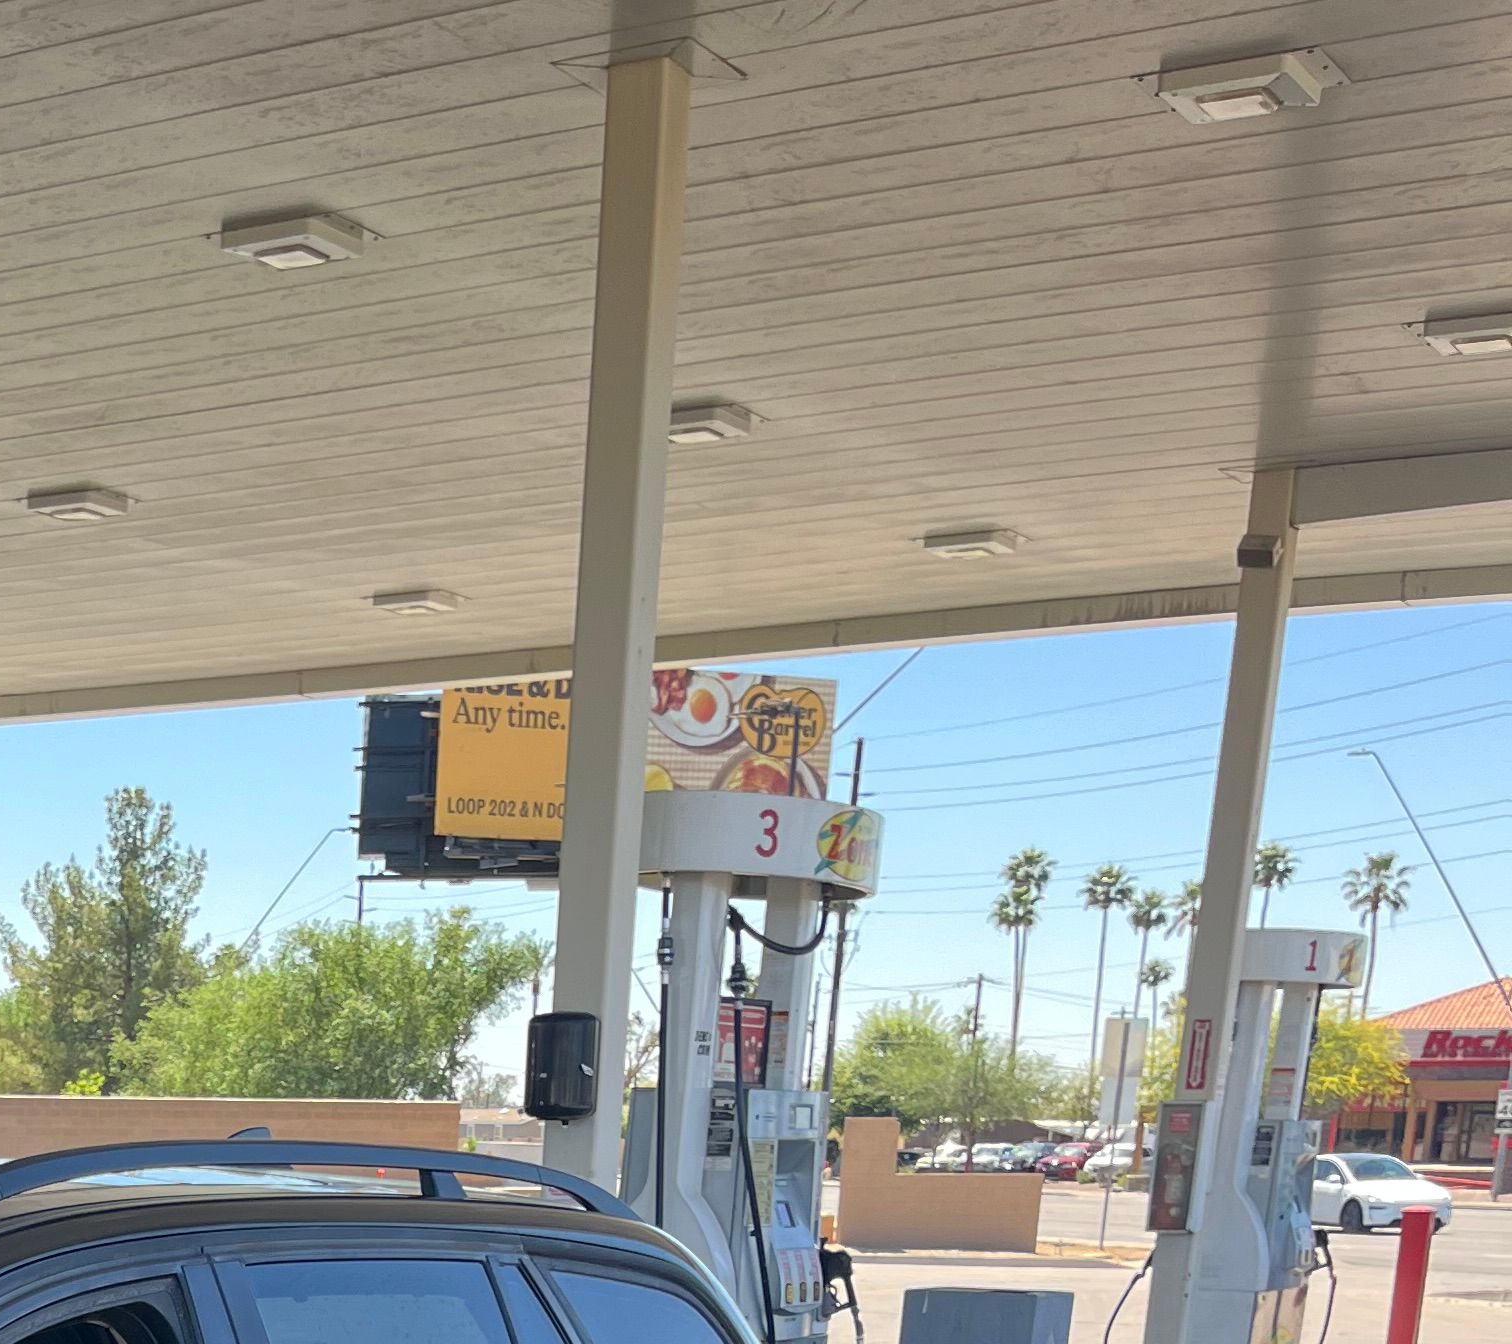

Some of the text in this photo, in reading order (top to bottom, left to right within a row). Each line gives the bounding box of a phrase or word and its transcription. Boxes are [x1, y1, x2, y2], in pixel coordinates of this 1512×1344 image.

[452, 697, 566, 733] Any time.
[756, 718, 817, 753] Barel
[447, 797, 485, 815] LOOP
[488, 800, 517, 817] 202
[519, 802, 529, 817] &
[533, 802, 543, 818] N
[755, 808, 780, 858] 3
[1304, 939, 1317, 971] 1
